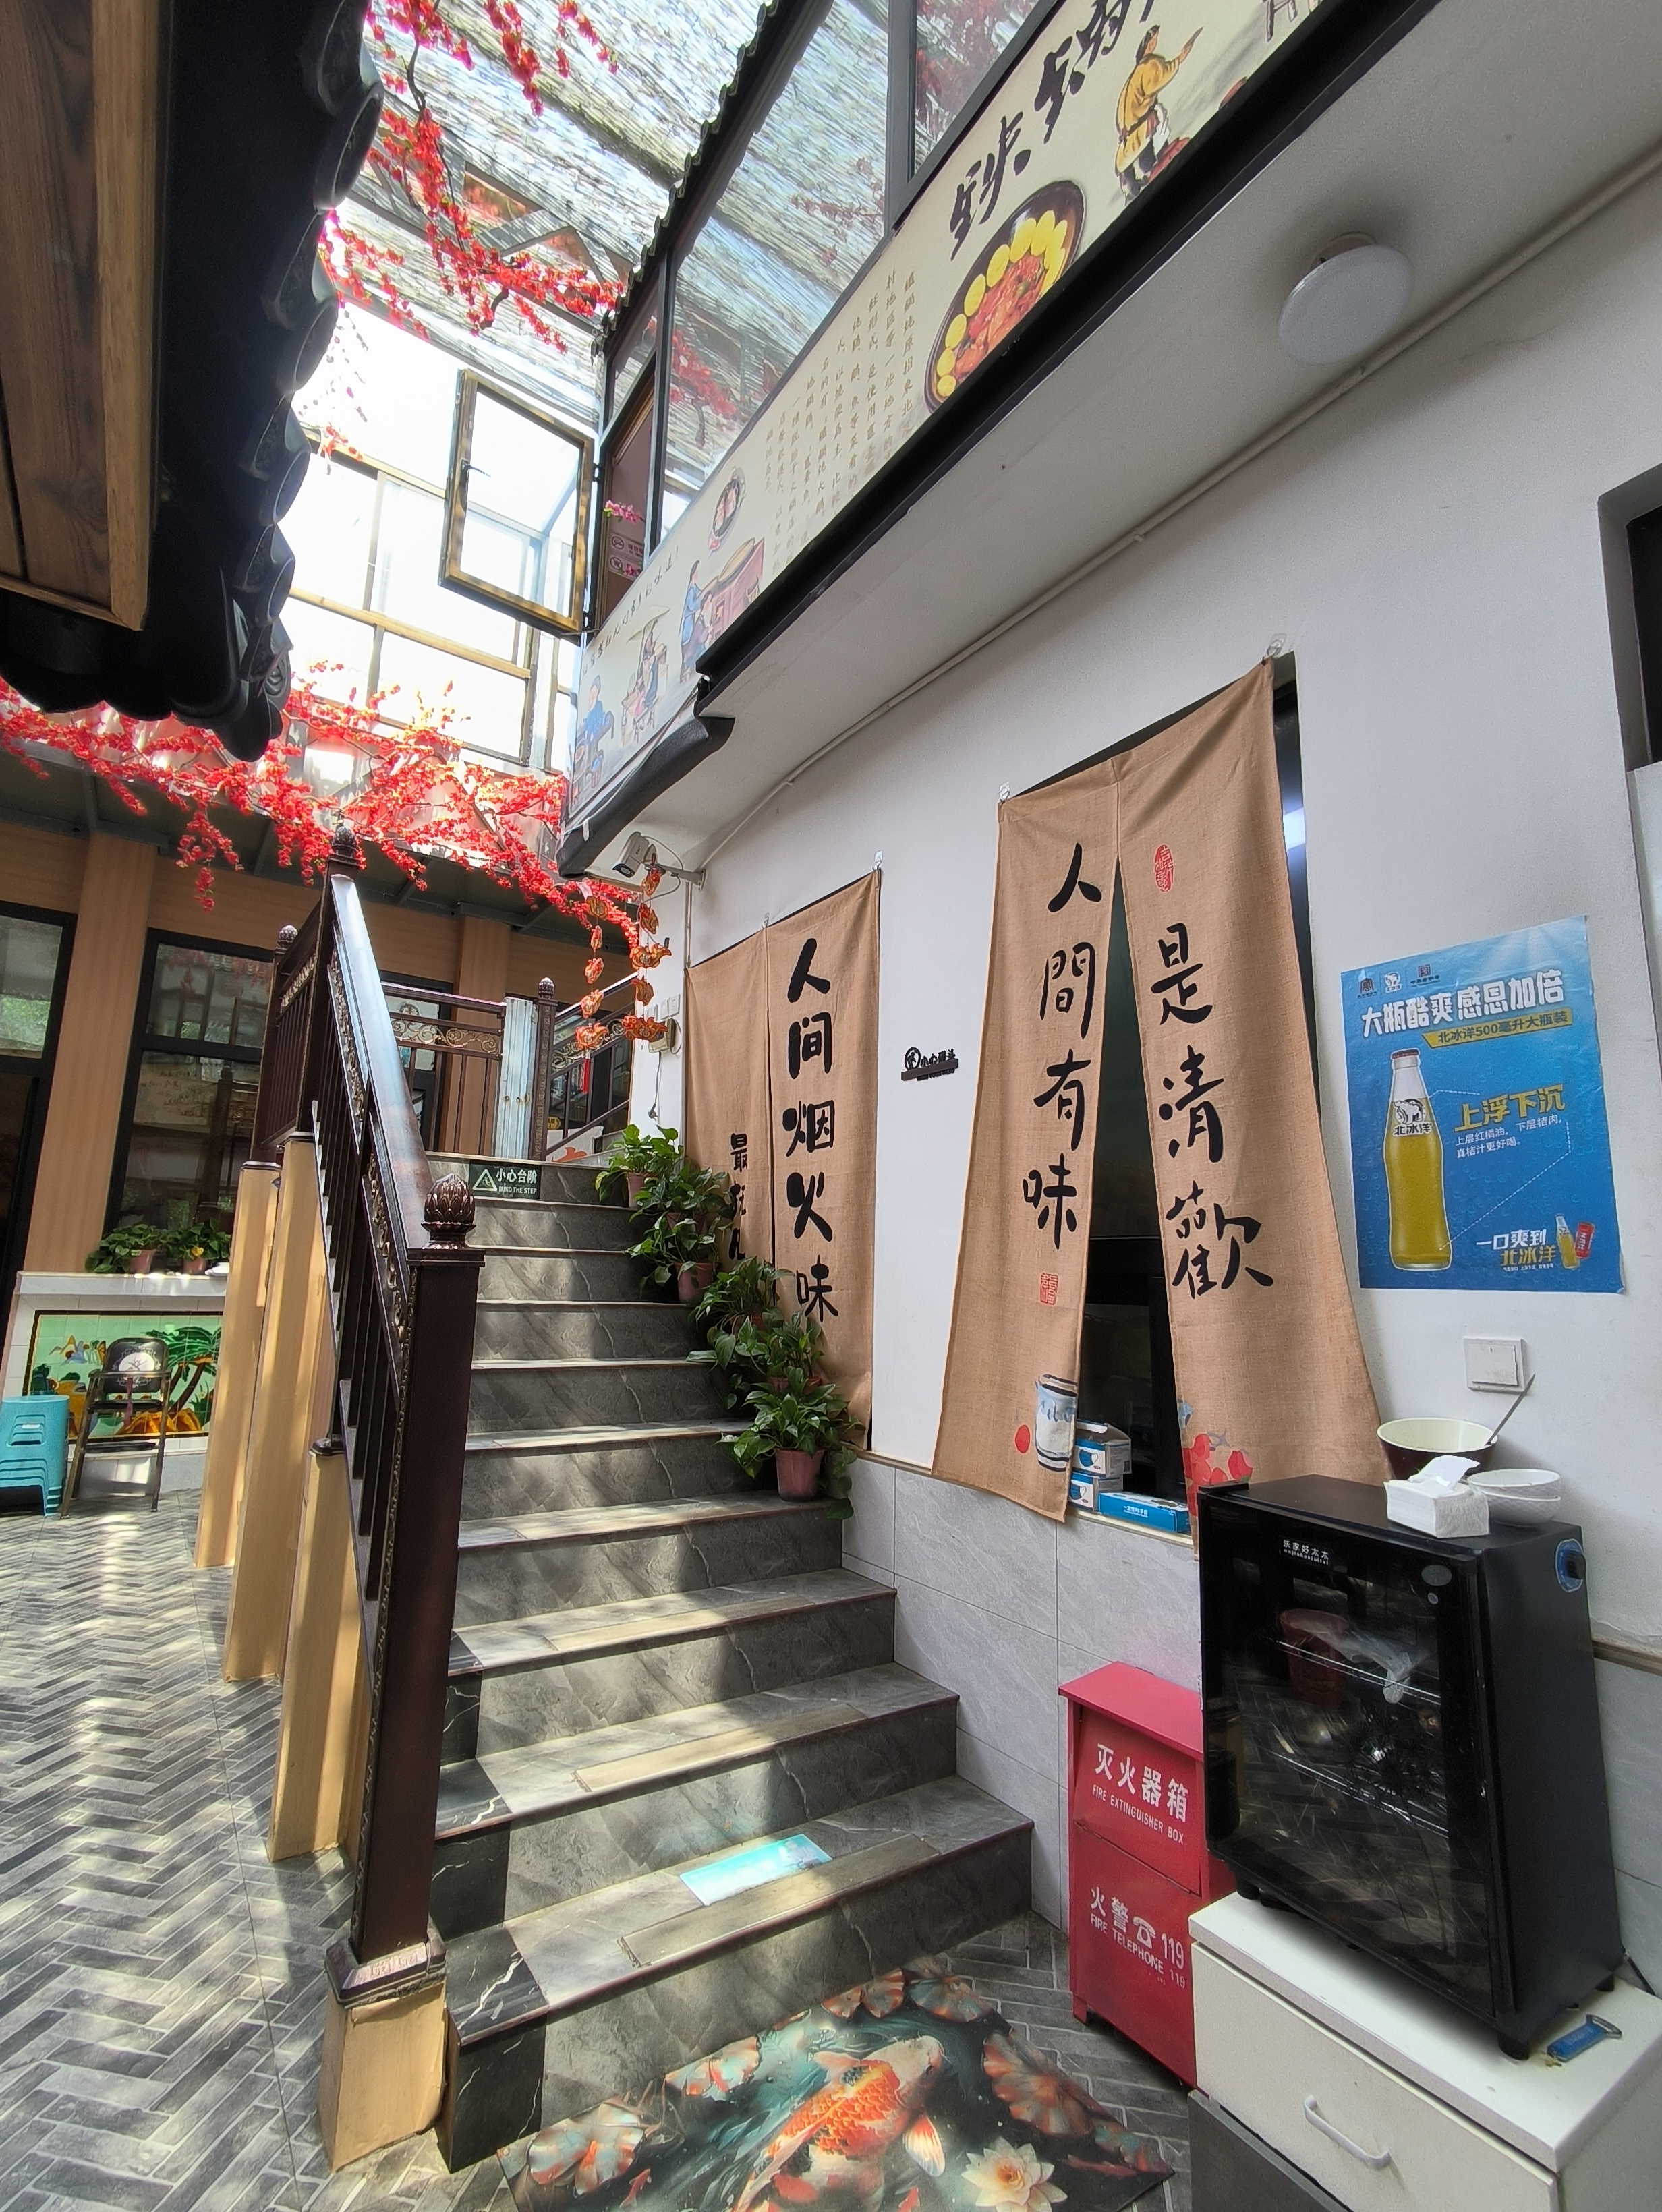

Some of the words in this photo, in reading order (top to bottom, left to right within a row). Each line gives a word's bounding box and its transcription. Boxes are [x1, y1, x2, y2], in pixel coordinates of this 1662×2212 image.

[1023, 842, 1102, 1249] 人間有味
[1438, 1010, 1568, 1044] 北冰洋500毫升大瓶装
[782, 938, 839, 1322] 人间烟火味
[1394, 1123, 1431, 1136] 北冰洋
[1454, 1084, 1566, 1132] 上浮下沉
[496, 1167, 538, 1184] 小心台阶
[498, 1185, 513, 1193] MIND
[1476, 1228, 1547, 1250] 一口爽到
[1500, 1244, 1556, 1267] 北冰洋
[1095, 1742, 1188, 1822] 灭火器箱
[1092, 1784, 1107, 1802] FIRE
[1110, 1794, 1164, 1834] EXTINGUISHER
[1168, 1826, 1184, 1844] BOX
[1090, 1913, 1108, 1935] FIRE
[1112, 1927, 1165, 1975] TELEPHONE
[1170, 1969, 1186, 1989] 119
[1091, 1886, 1129, 1933] 火警
[1162, 1932, 1185, 1969] 119
